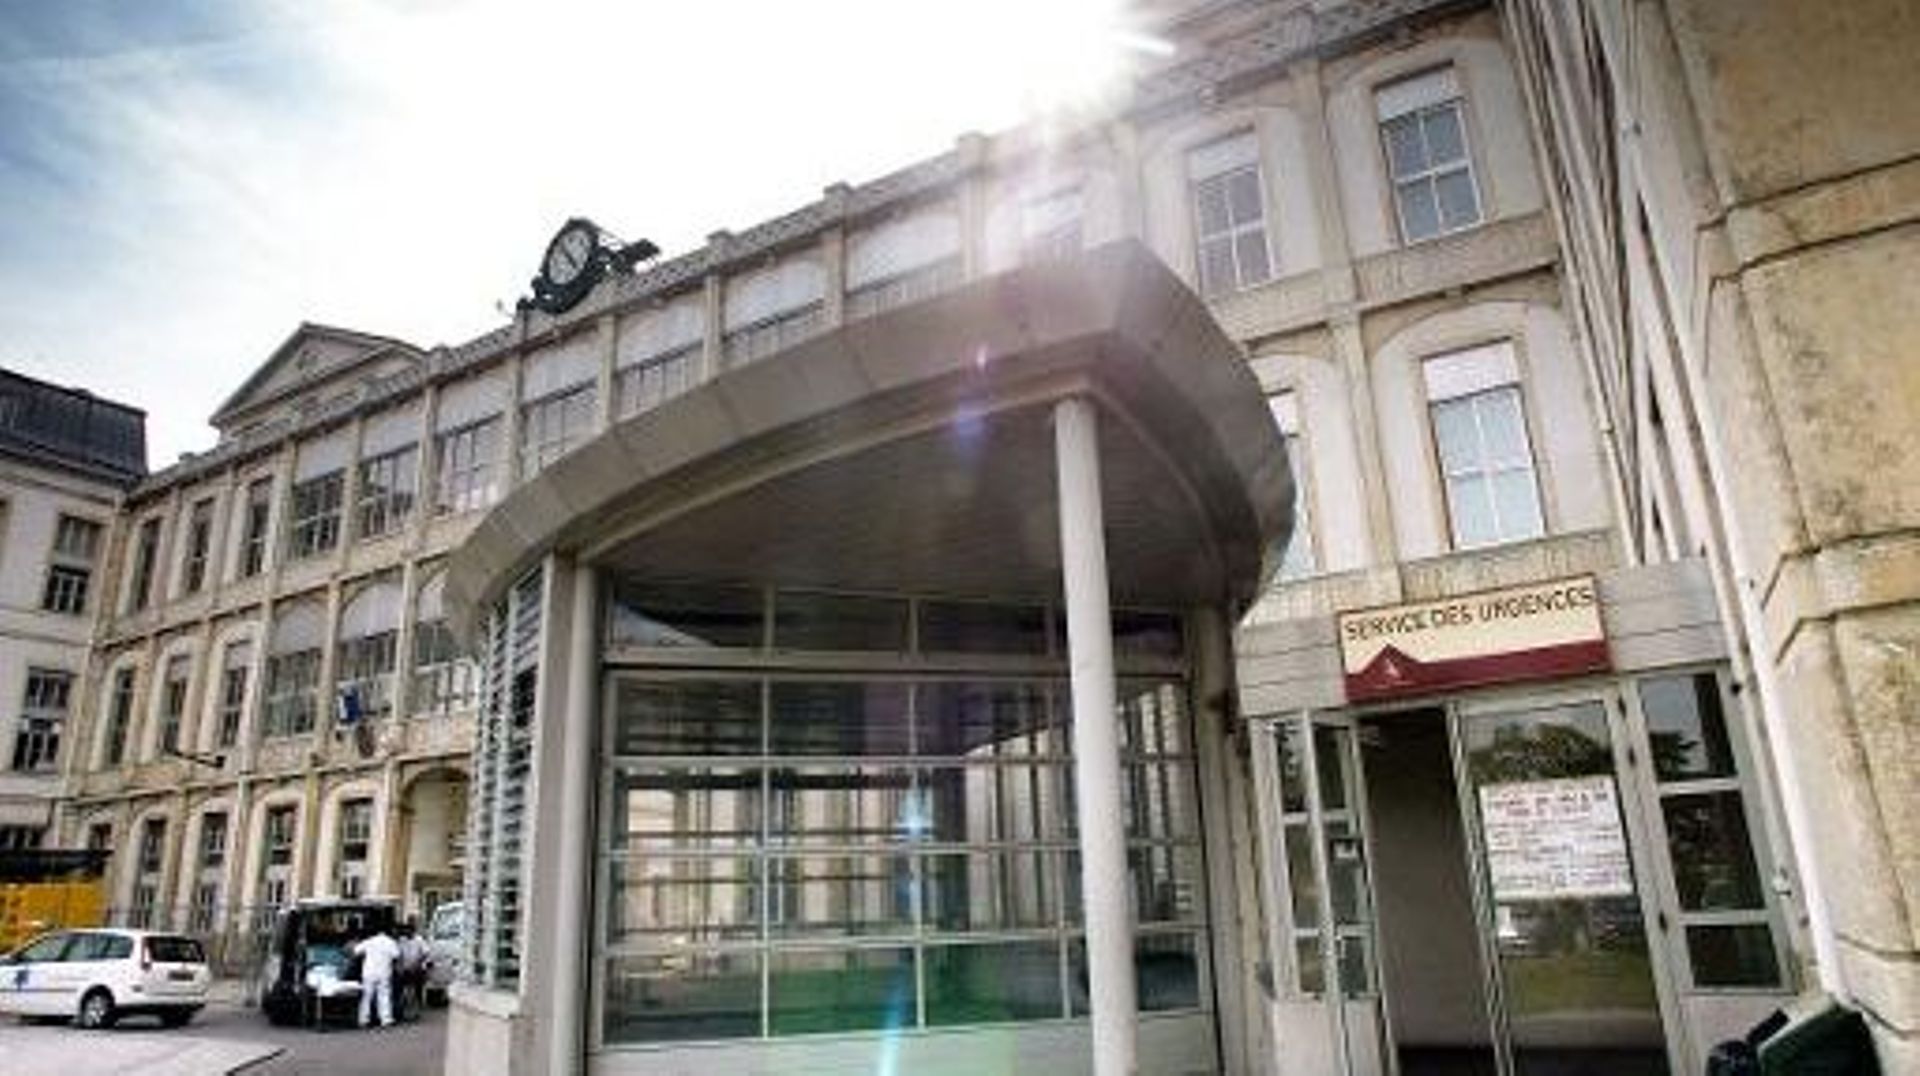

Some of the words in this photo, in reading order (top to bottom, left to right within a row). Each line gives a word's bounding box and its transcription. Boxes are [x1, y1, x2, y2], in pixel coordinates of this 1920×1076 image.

[1344, 610, 1427, 641] SERVICE
[1431, 605, 1473, 627] DES
[1479, 586, 1592, 621] URGENCES
